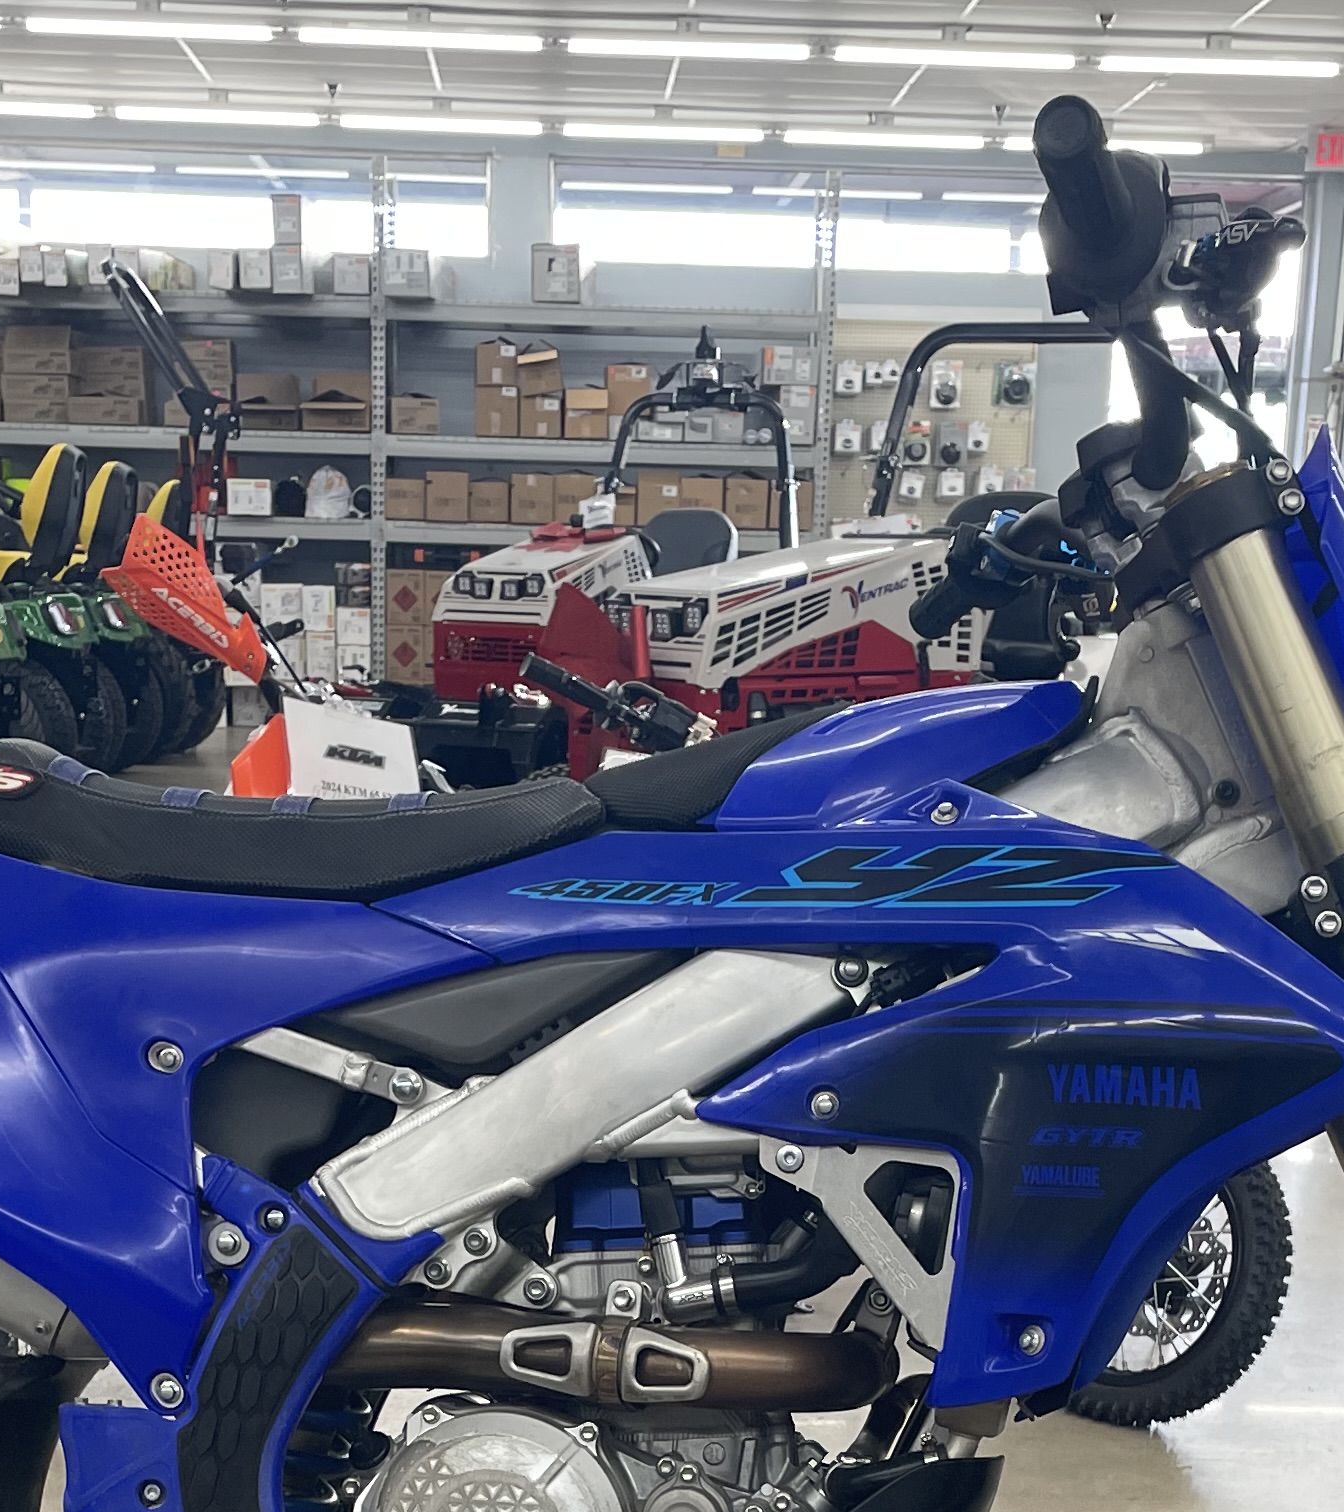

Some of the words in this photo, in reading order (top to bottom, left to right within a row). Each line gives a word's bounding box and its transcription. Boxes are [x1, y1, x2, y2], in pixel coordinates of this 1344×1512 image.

[150, 587, 230, 649] ACERBIS
[323, 744, 386, 769] KTM
[343, 784, 367, 797] KTM
[507, 878, 739, 904] 450FX
[1047, 1063, 1202, 1111] YAMAHA
[1028, 1124, 1147, 1149] GYTR
[1021, 1164, 1101, 1188] YAMALUBE
